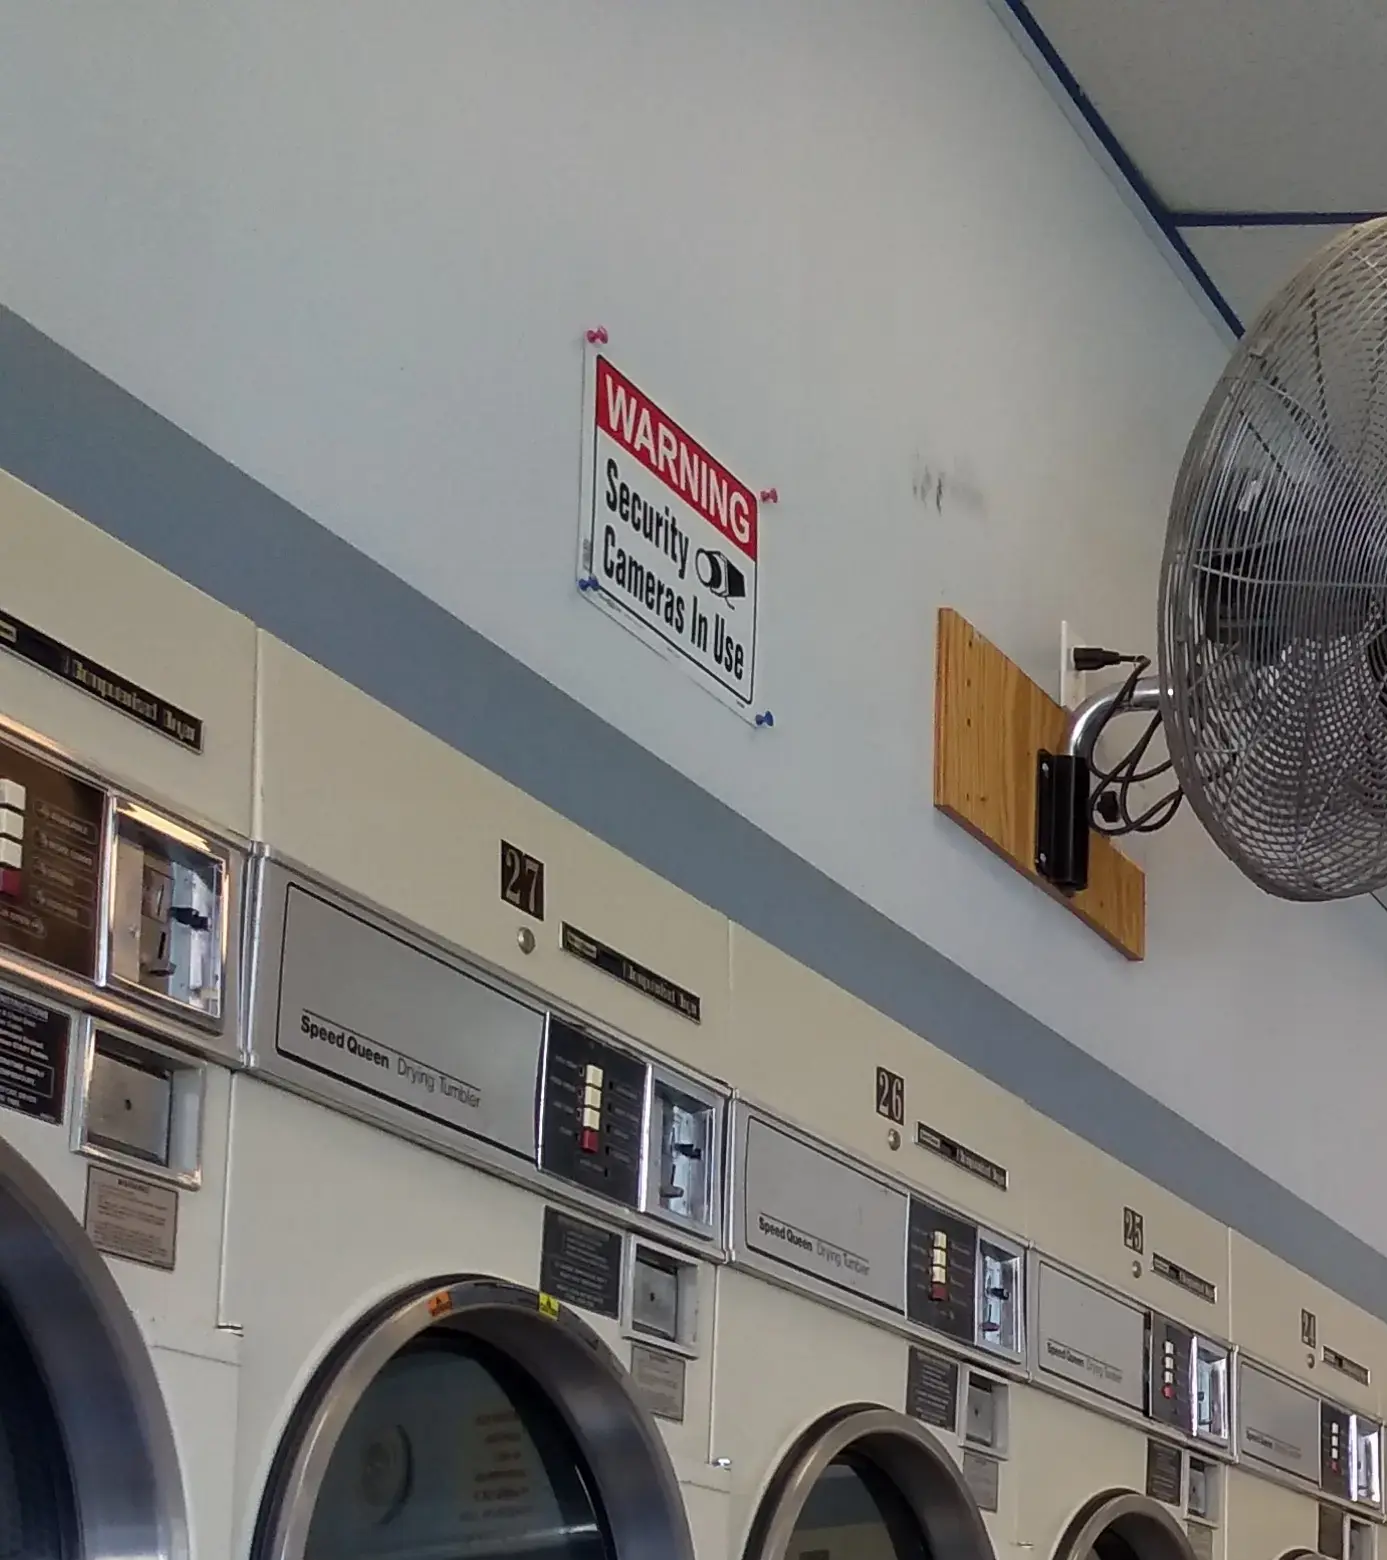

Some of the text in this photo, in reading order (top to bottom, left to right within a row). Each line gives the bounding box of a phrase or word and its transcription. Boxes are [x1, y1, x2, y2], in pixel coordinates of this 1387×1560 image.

[604, 374, 750, 544] WARNING
[605, 458, 689, 580] Security
[603, 524, 685, 634] Cameras
[690, 595, 708, 653] In
[713, 613, 744, 681] Use
[505, 848, 539, 913] 27
[301, 1014, 481, 1108] Speed Queen Drying Tumbler
[878, 1071, 903, 1122] 26
[759, 1216, 785, 1240] Speed
[786, 1229, 813, 1252] Queen
[1125, 1210, 1142, 1252] 25
